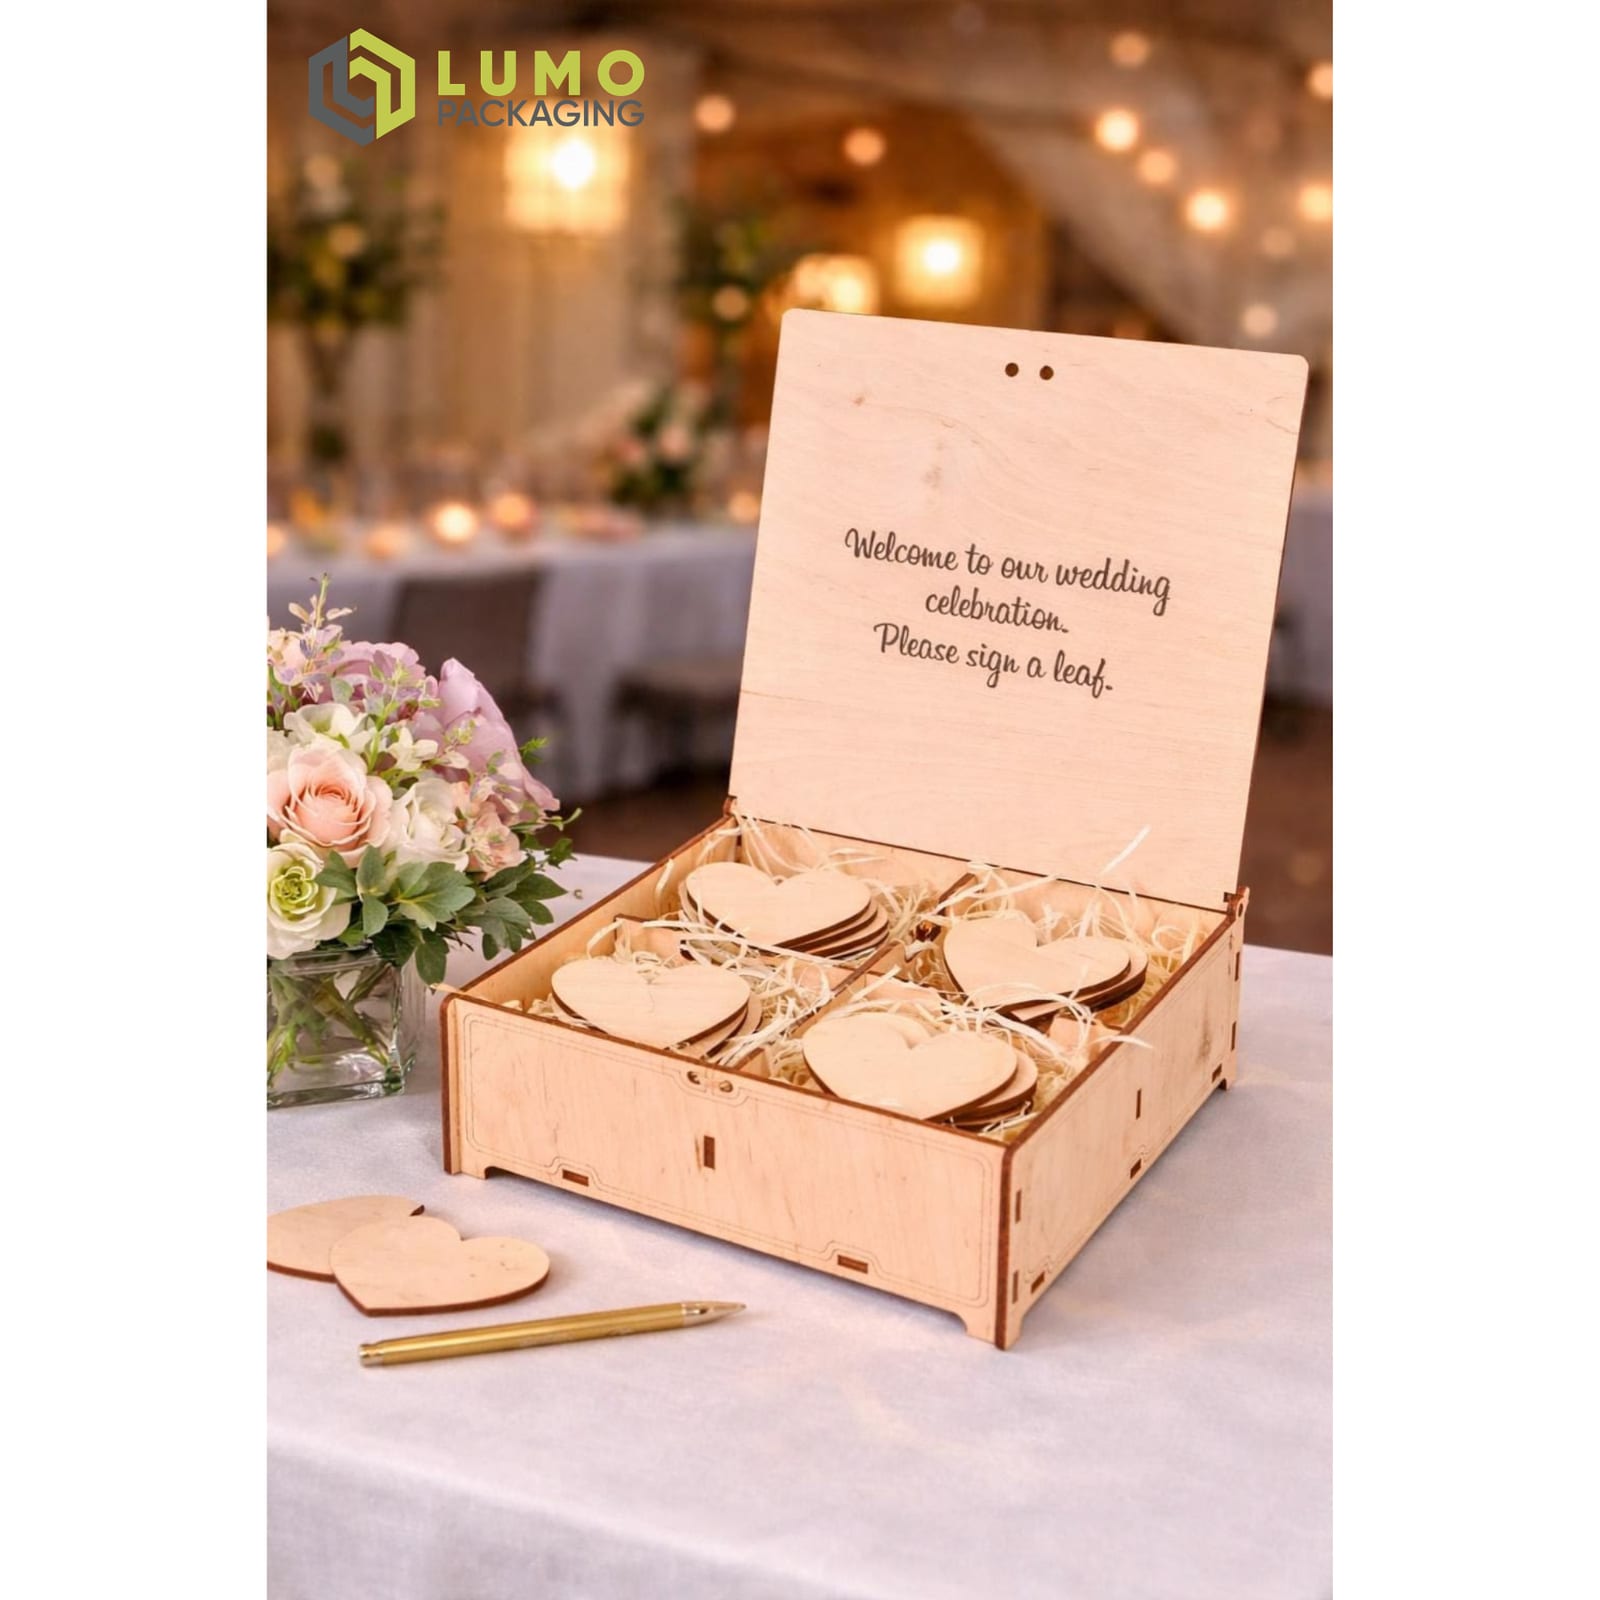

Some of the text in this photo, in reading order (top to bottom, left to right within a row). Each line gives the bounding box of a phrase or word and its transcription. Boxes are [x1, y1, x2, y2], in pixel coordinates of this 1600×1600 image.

[844, 527, 1171, 617] Welcome to our wedding
[925, 585, 1070, 634] celebration.
[873, 622, 1114, 699] Please sign a leaf.
